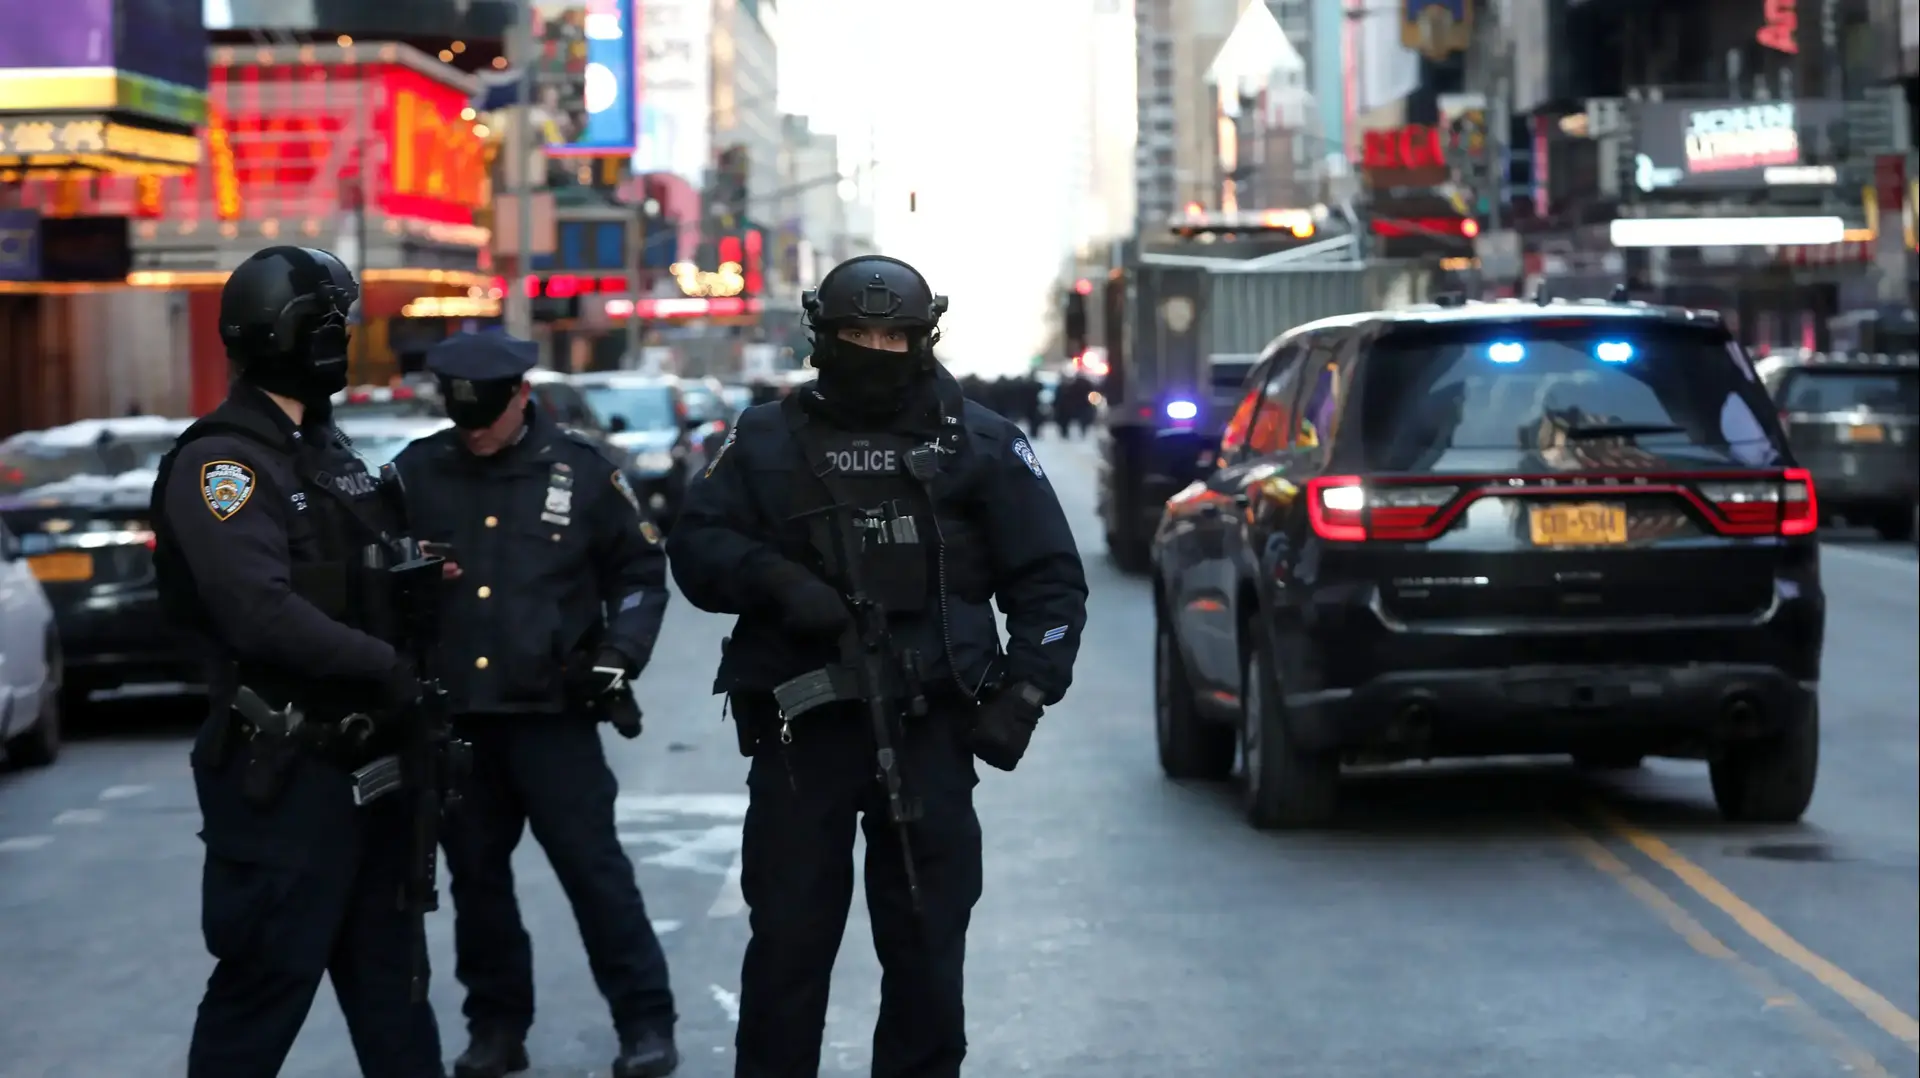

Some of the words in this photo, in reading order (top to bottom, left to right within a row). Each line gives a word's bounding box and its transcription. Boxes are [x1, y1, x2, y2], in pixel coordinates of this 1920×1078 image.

[826, 450, 896, 471] POLICE
[215, 464, 242, 473] POLICE
[206, 470, 251, 482] DEPARTMENT
